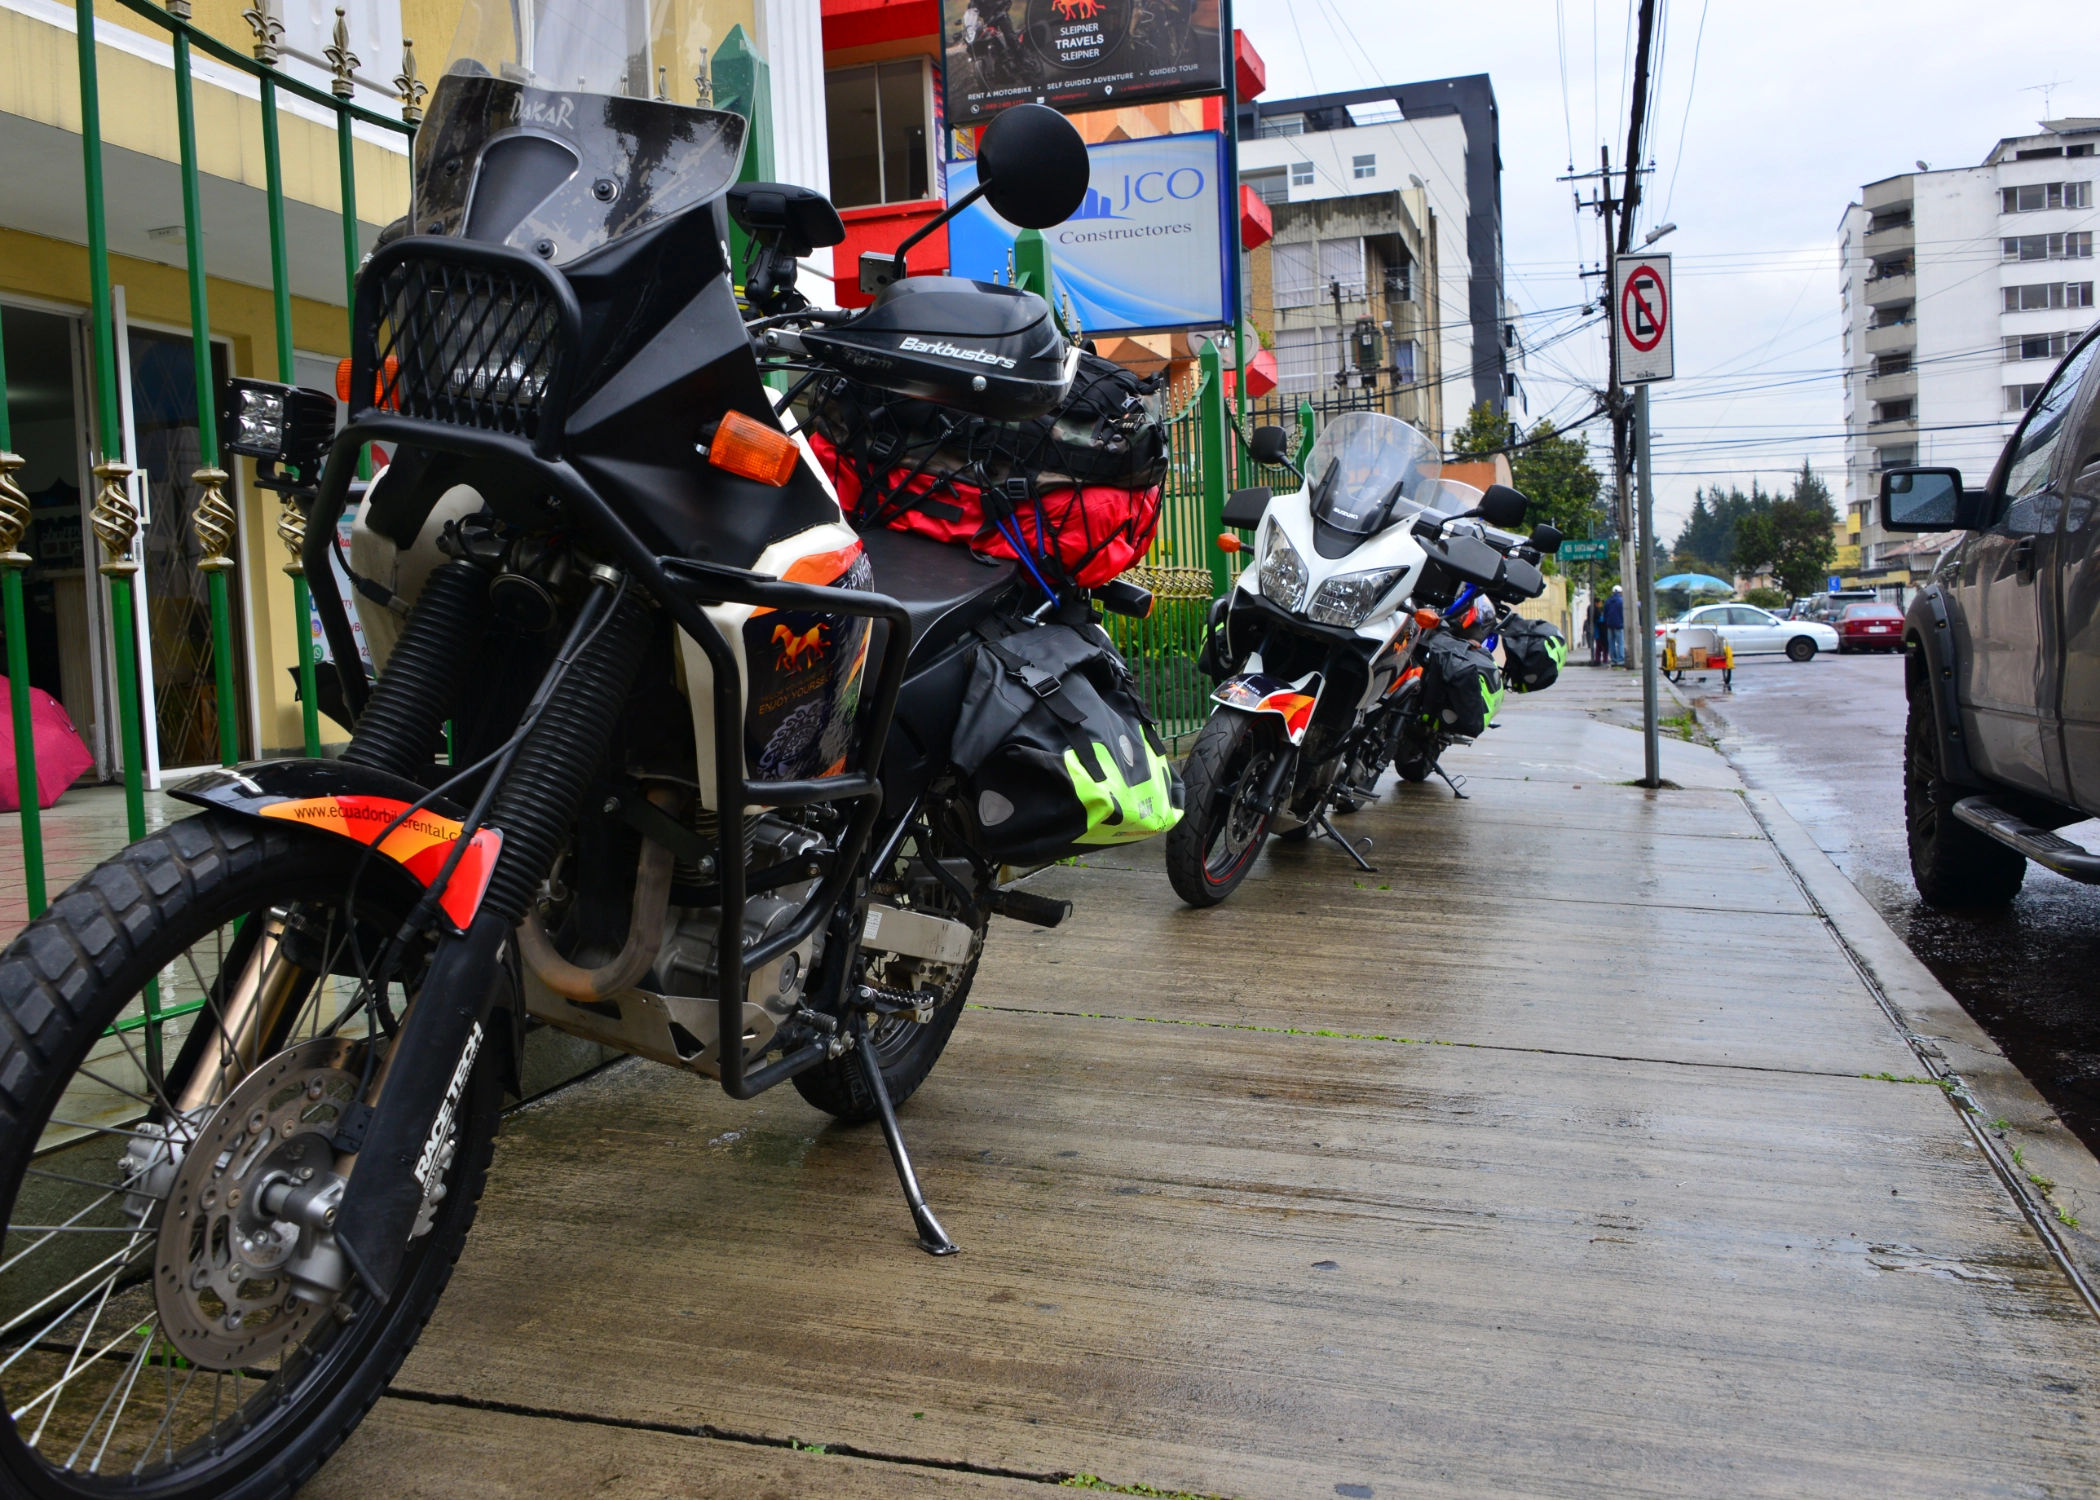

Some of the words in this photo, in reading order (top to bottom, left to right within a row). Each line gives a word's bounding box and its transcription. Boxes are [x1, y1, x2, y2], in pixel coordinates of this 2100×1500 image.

[1055, 34, 1104, 50] TRAVELS
[1060, 23, 1099, 36] SLEIPNER
[1061, 49, 1100, 62] SLEIPNER
[968, 92, 985, 101] RENT
[993, 86, 1032, 97] MOTORBIKE
[1047, 81, 1063, 91] SELF
[1064, 78, 1091, 88] GUIDED
[1093, 72, 1134, 84] ADVENTURE
[1149, 67, 1177, 76] GUIDED
[1178, 63, 1199, 73] TOUR
[509, 91, 575, 130] DAKAR
[1120, 167, 1205, 211] JCO
[1059, 221, 1192, 245] Constructores
[899, 336, 1018, 370] Barkbusters
[1333, 507, 1359, 520] SUZUKI
[759, 693, 790, 715] ENJOY
[791, 669, 834, 700] YOURSELF
[294, 804, 483, 849] www.ecuadorbierental.cm
[414, 1099, 453, 1184] RACE
[446, 1020, 483, 1100] TECH
